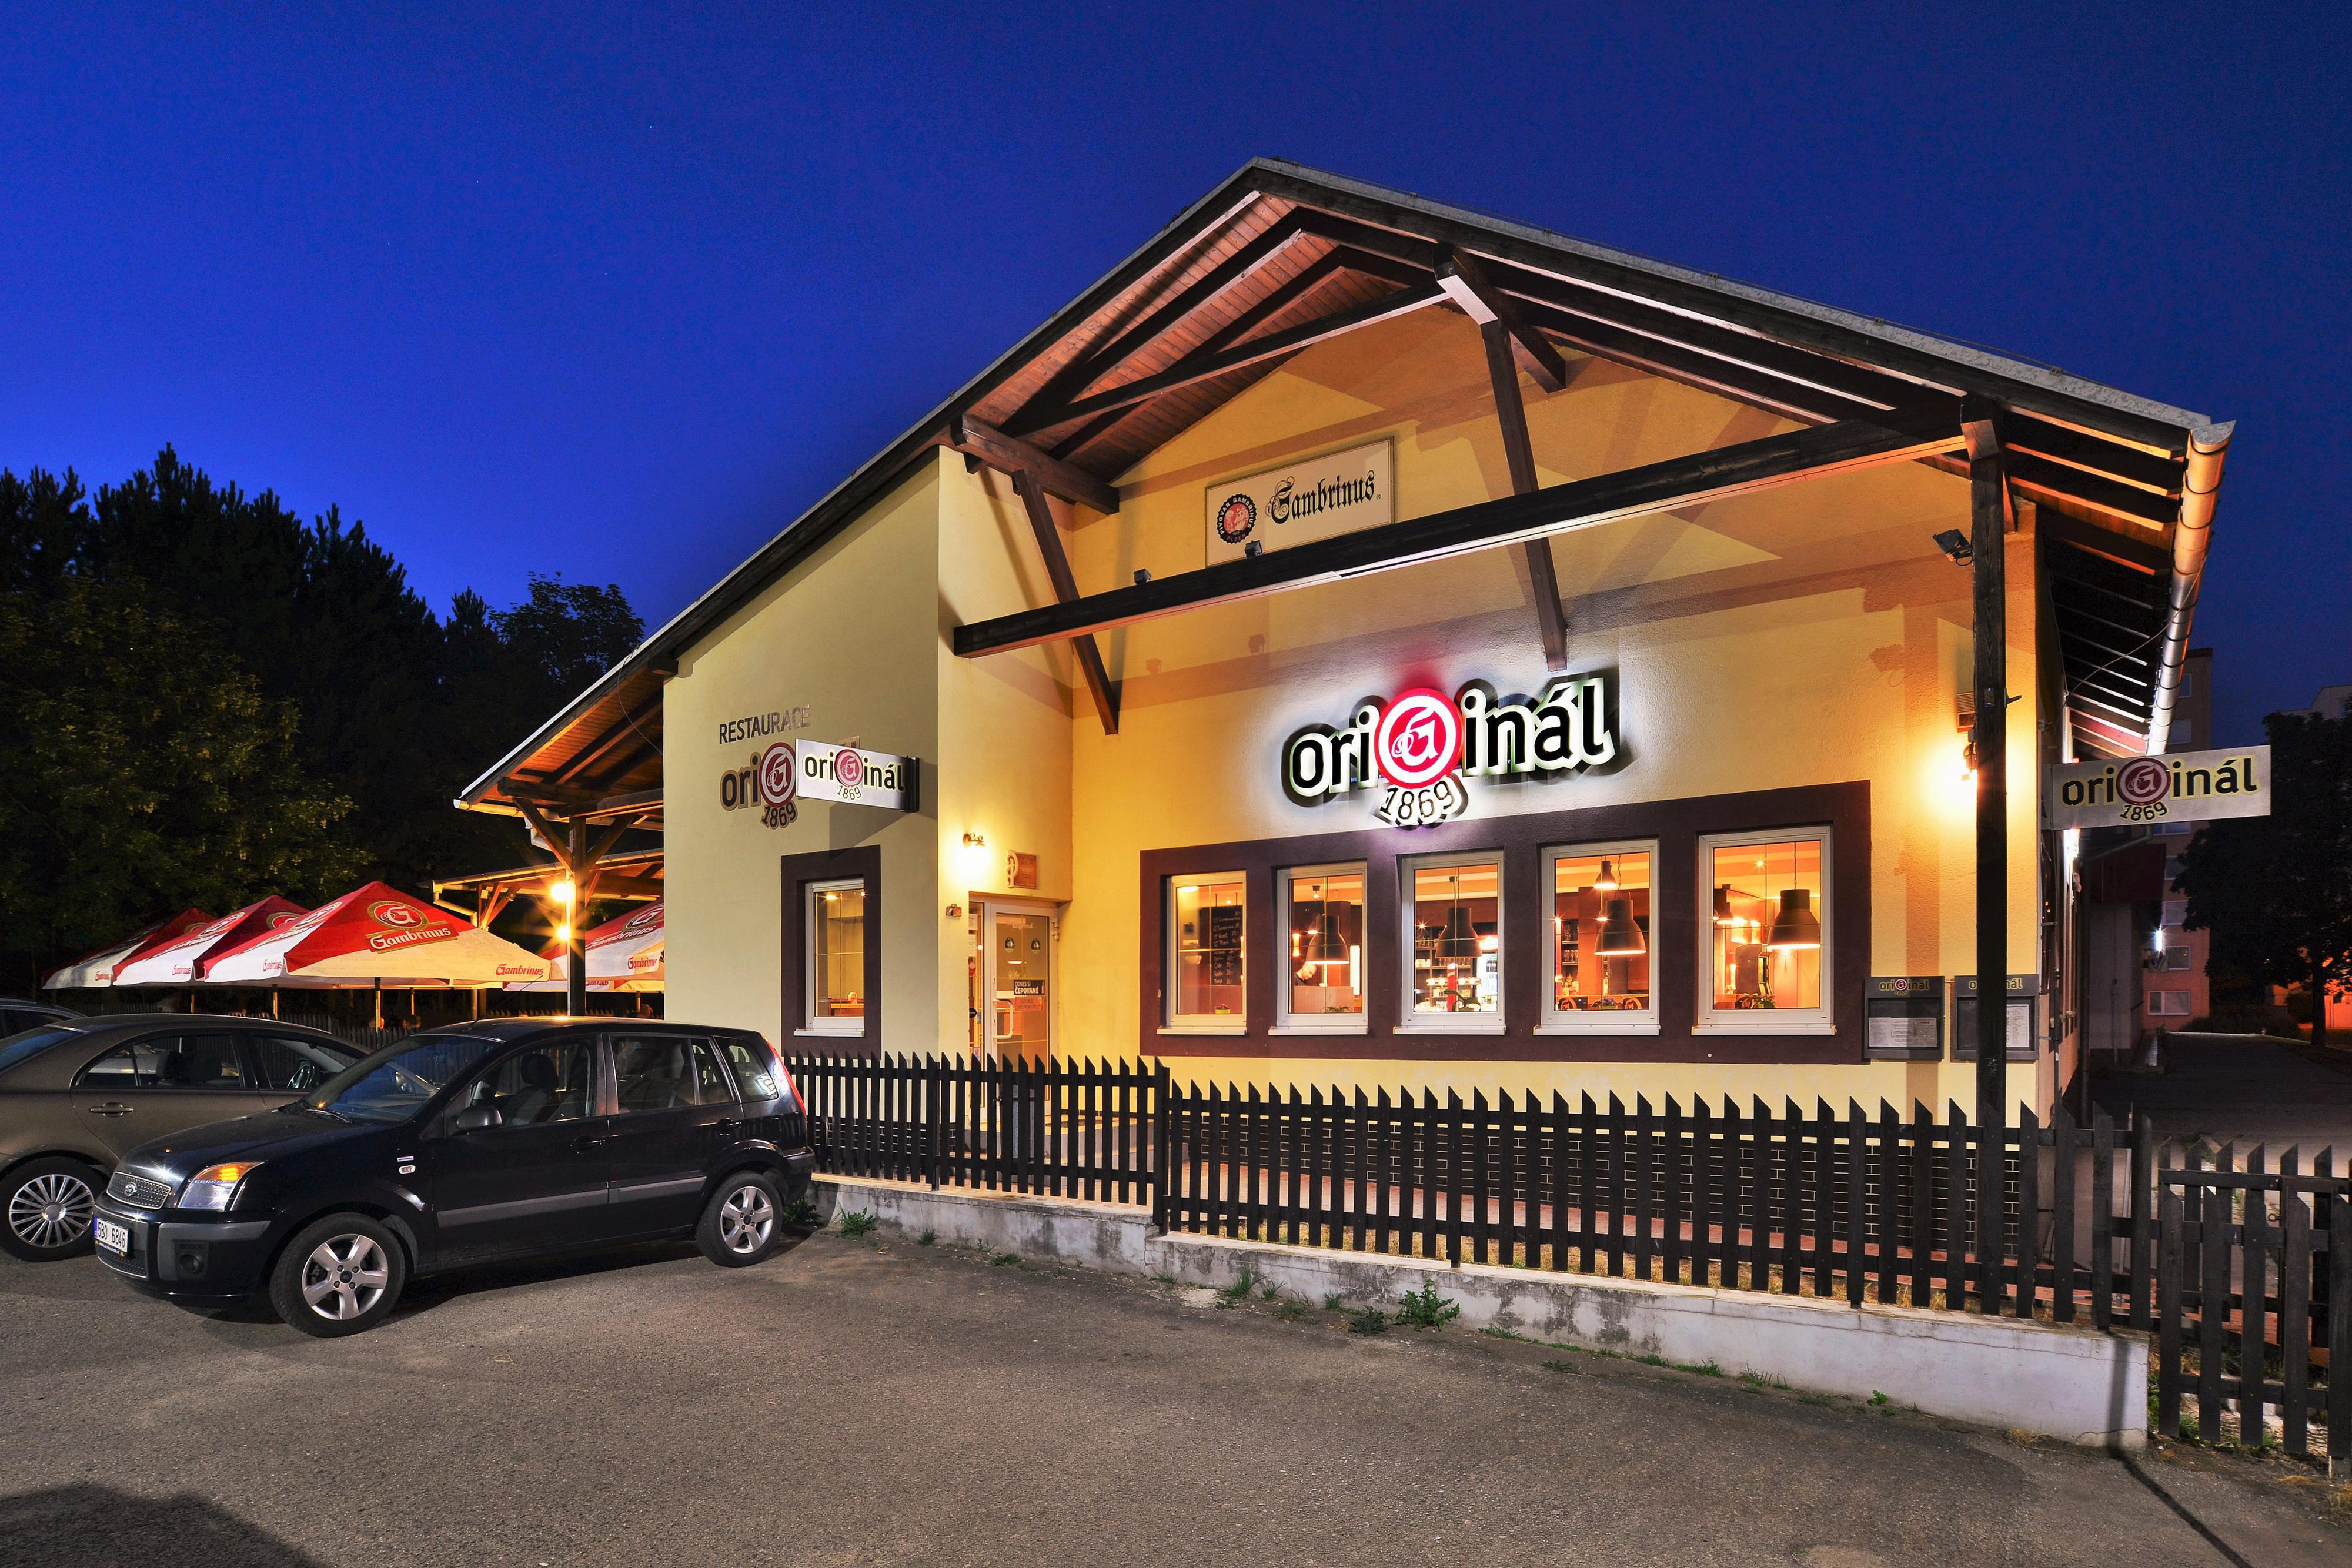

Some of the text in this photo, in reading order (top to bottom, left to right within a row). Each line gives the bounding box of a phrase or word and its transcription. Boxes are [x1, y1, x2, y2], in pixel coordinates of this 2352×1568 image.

[1218, 497, 1254, 534] PIVOVAR GAMBRINUS
[719, 704, 810, 744] RESTAURACE
[837, 785, 862, 800] 1869
[1381, 780, 1455, 821] 1869
[761, 801, 797, 828] 1869
[2119, 801, 2168, 821] 1869
[370, 927, 452, 950] Gambrinus
[495, 963, 544, 976] Gambrinus
[627, 957, 658, 970] Gambrinus
[111, 1228, 126, 1248] 6846
